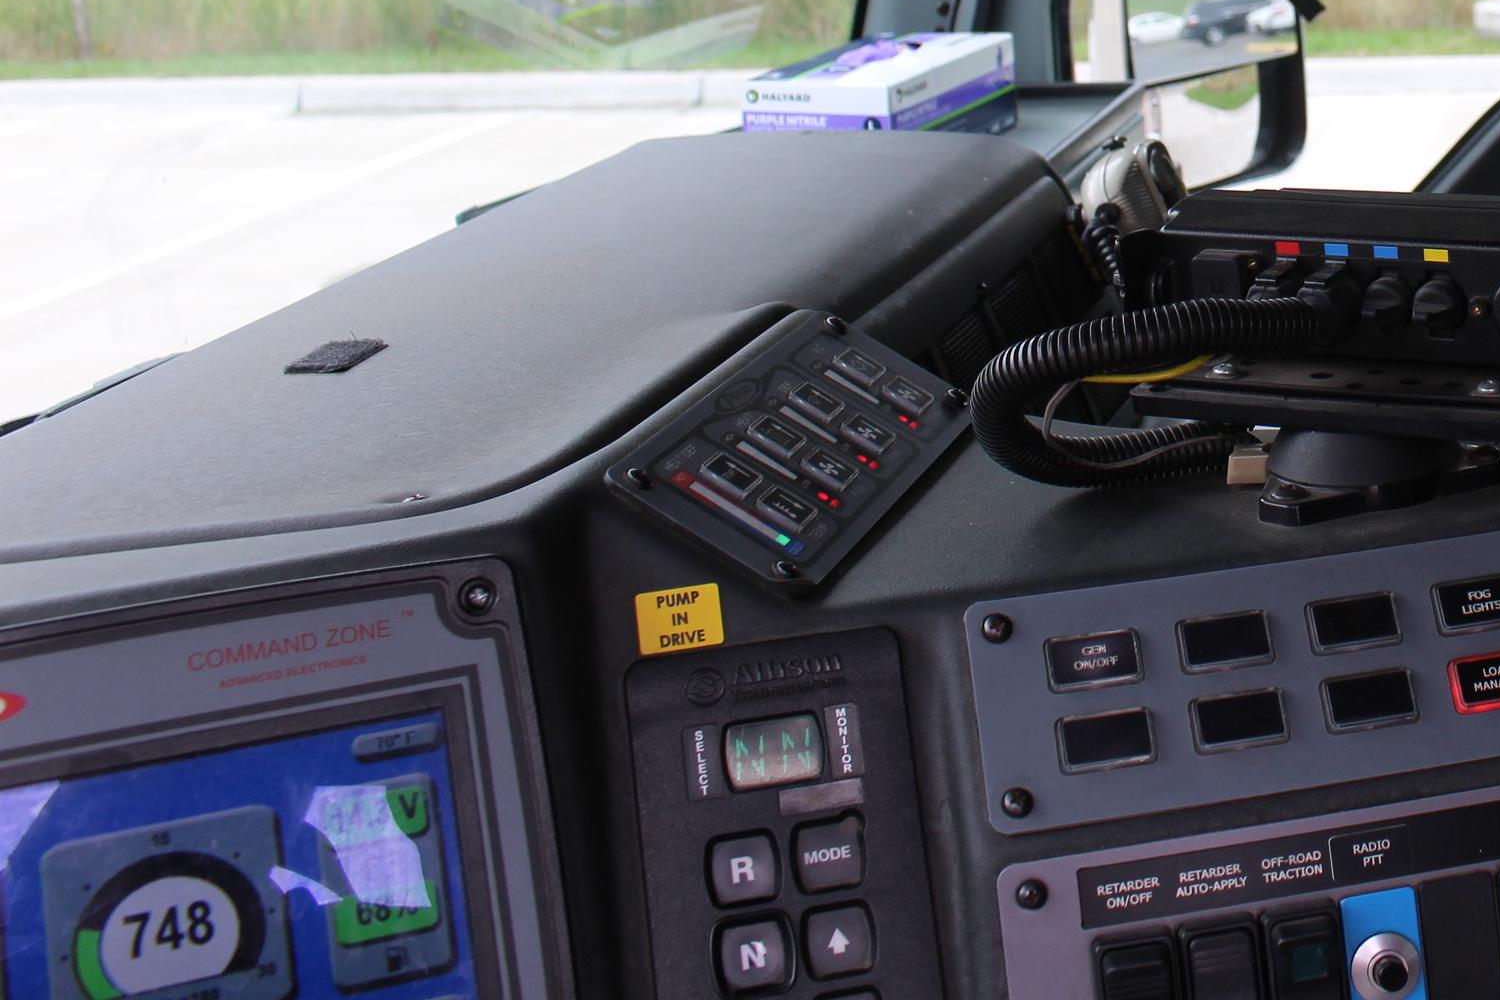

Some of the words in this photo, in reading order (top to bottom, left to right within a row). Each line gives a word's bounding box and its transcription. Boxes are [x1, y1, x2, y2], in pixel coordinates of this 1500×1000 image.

[761, 92, 811, 102] HALYARD
[746, 113, 786, 126] PURPLE
[787, 115, 828, 128] NITRILE
[656, 591, 700, 608] PUMP
[1467, 589, 1491, 601] FOG
[672, 612, 688, 626] IN
[187, 632, 318, 672] COMMAND
[325, 619, 391, 645] ZONE
[659, 629, 705, 648] DRIVE
[1081, 644, 1106, 655] GEN
[1073, 655, 1119, 670] ON/OFF
[835, 707, 853, 774] MONITOR
[694, 730, 709, 796] SELECT
[804, 845, 851, 865] MODE
[1353, 839, 1390, 854] RADIO
[1261, 851, 1321, 869] OFF-ROAD
[1363, 854, 1384, 866] PTT
[730, 855, 755, 884] R
[1178, 864, 1241, 883] RETARDER
[1262, 864, 1323, 882] TRACTION
[1096, 876, 1160, 896] RETARDER
[1175, 876, 1248, 898] AUTO-APPLY
[1107, 892, 1152, 909] ON/OFF
[123, 902, 215, 959] 748
[740, 941, 767, 971] N
